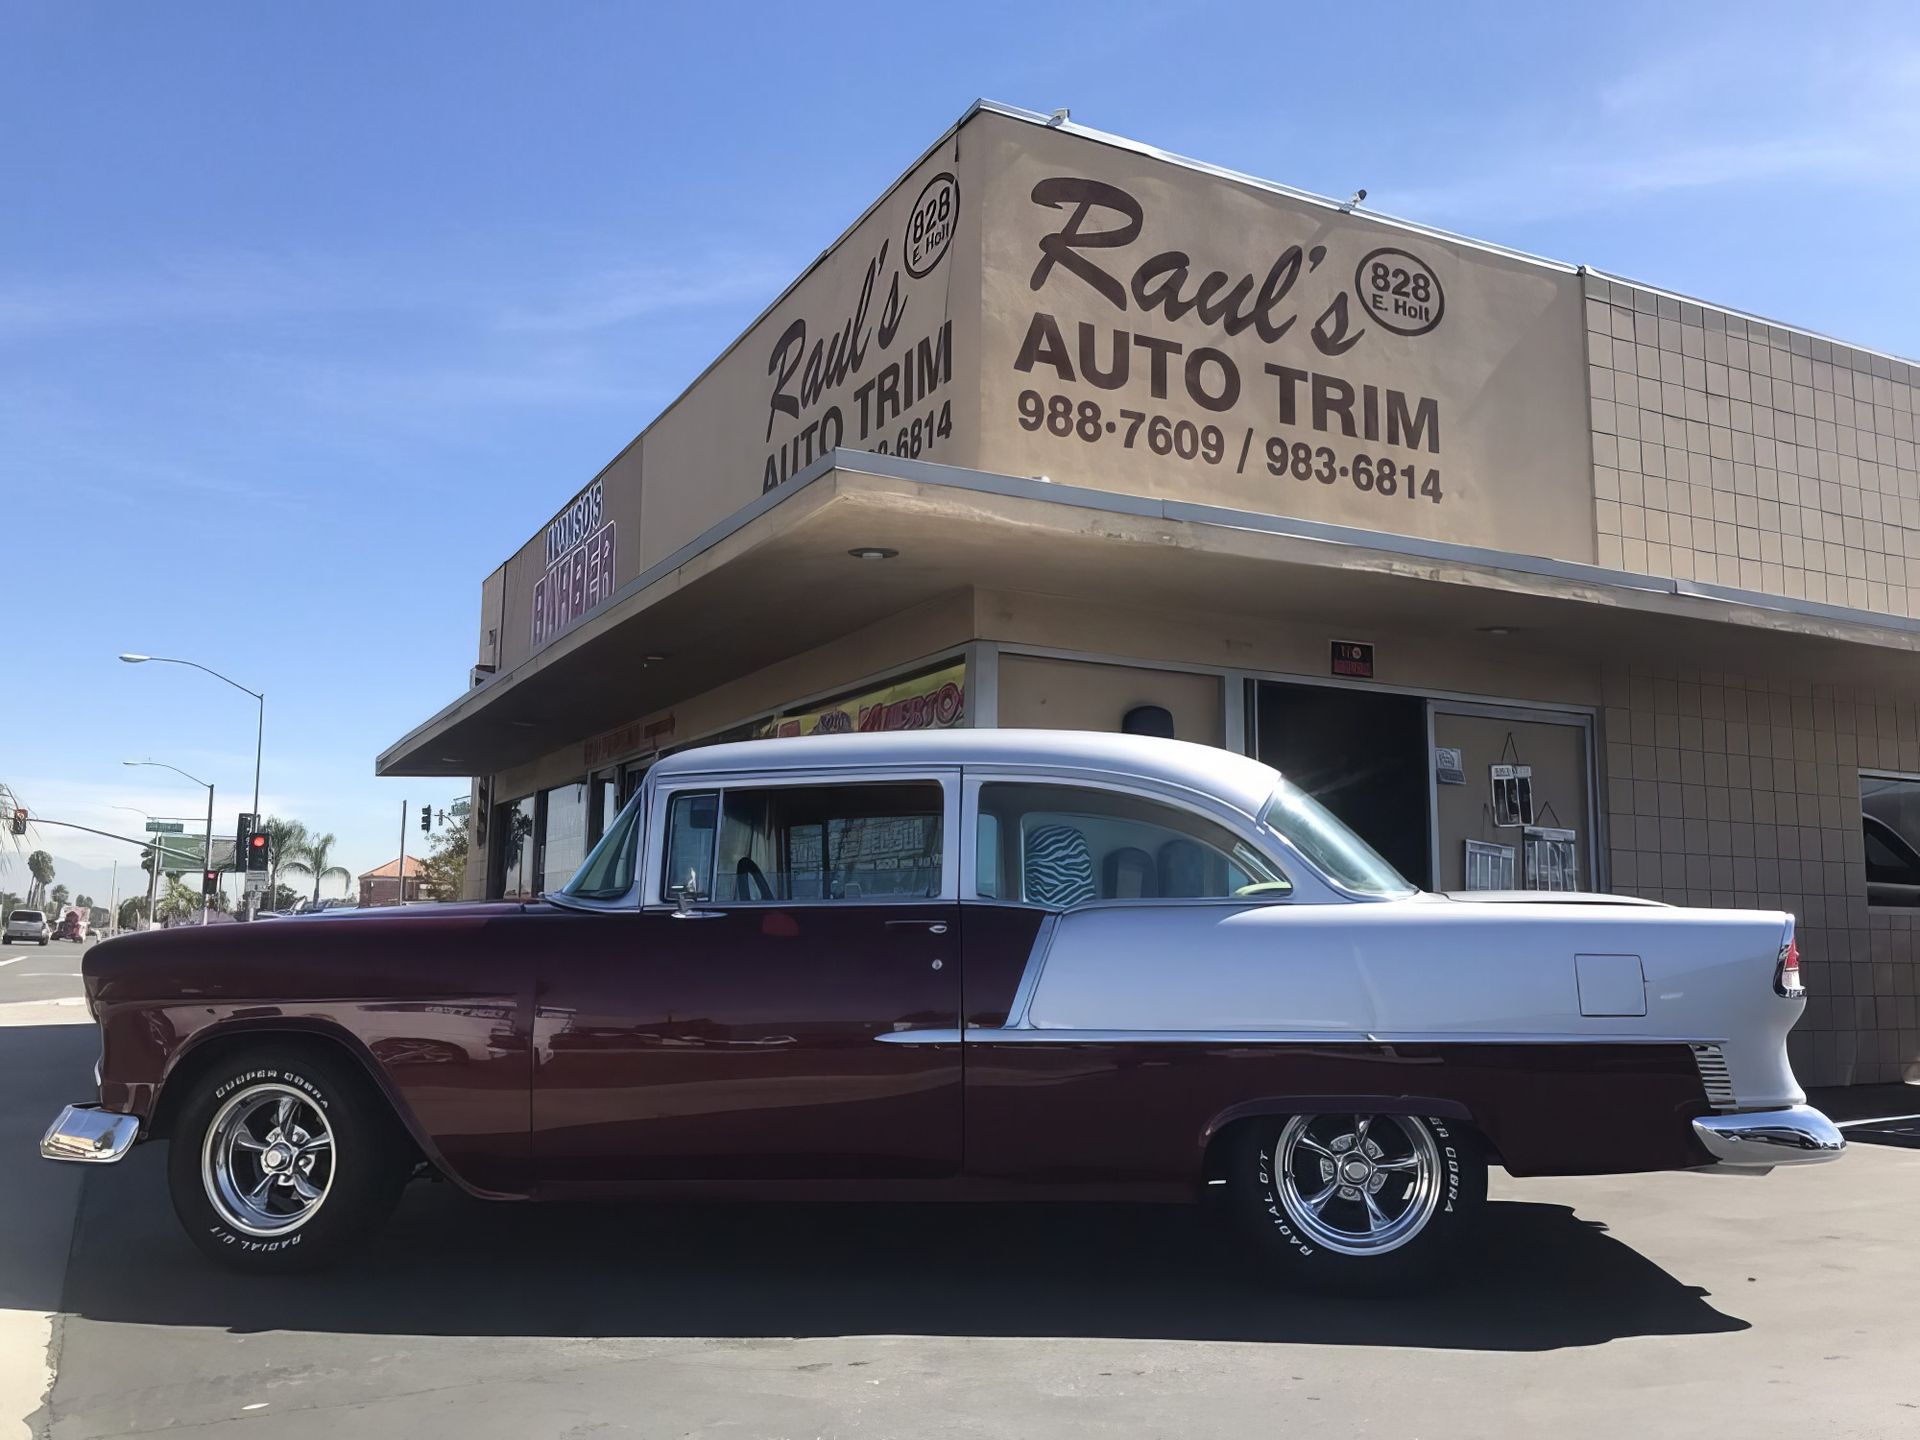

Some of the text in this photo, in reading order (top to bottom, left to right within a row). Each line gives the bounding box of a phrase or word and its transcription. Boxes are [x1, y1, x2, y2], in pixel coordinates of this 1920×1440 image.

[914, 186, 950, 244] 828
[1031, 177, 1365, 356] Raul's
[1372, 262, 1430, 303] 828
[766, 238, 908, 443] Raul's
[762, 320, 952, 494] AUTO TRIM
[1013, 312, 1440, 453] AUTO TRIM
[1237, 428, 1254, 474] /
[1445, 1147, 1459, 1212] COBRA
[242, 1234, 301, 1251] RADIAL
[1264, 1192, 1313, 1256] RADIAL
